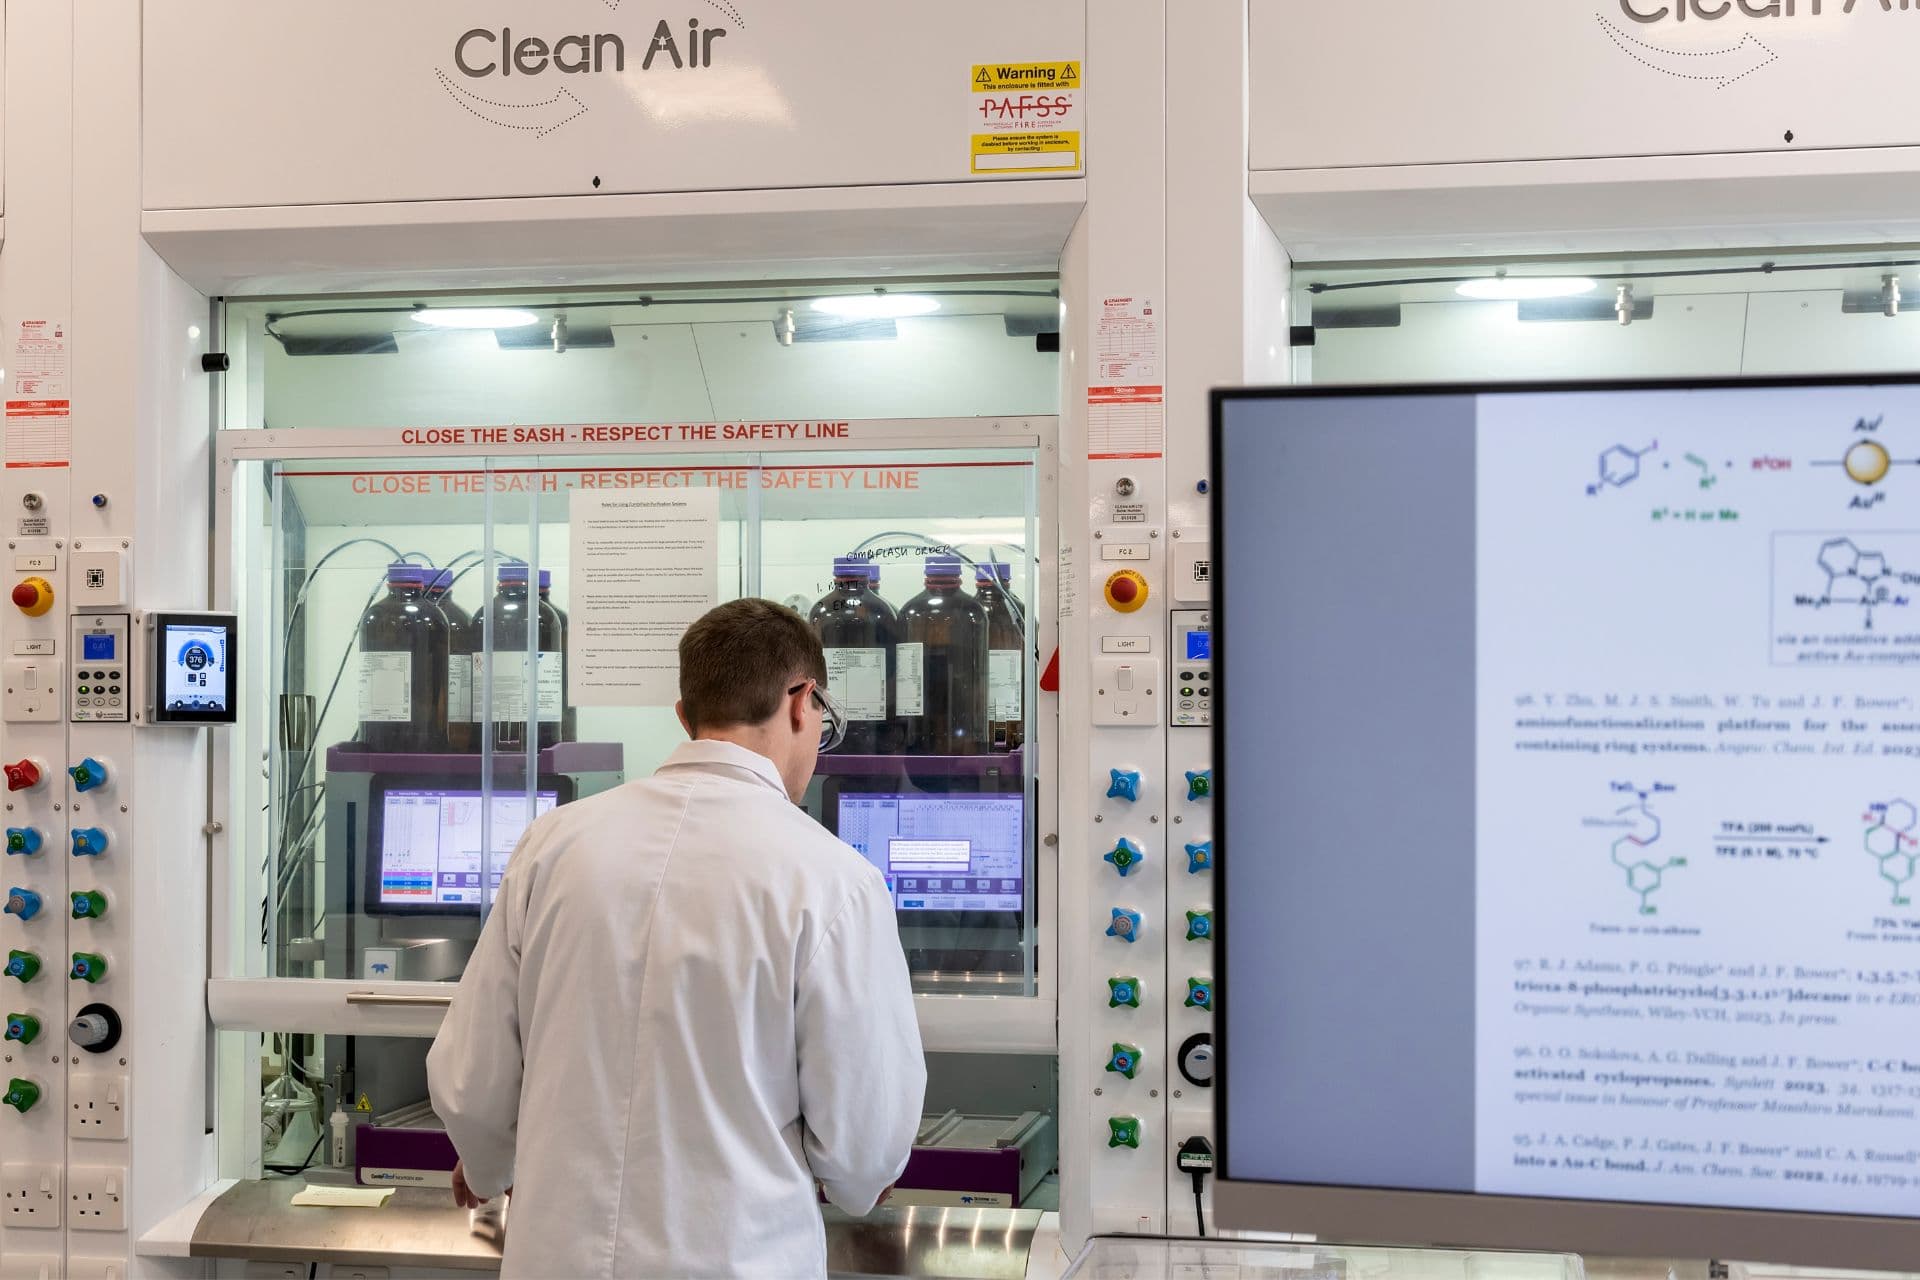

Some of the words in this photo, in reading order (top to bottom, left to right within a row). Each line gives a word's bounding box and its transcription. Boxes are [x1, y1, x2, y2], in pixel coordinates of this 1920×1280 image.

[454, 26, 625, 77] Clean
[642, 18, 727, 71] Air
[996, 66, 1056, 80] Warning
[401, 428, 464, 444] CLOSE
[470, 428, 507, 443] THE
[513, 427, 564, 442] SASH
[582, 426, 672, 442] RESPECT
[678, 425, 716, 440] THE
[722, 424, 798, 440] SAFETY
[804, 423, 849, 438] LINE
[352, 476, 432, 494] CLOSE
[439, 474, 484, 493] THE
[580, 471, 694, 489] RESPECT
[702, 471, 748, 489] THE
[760, 470, 853, 489] SAFETY
[864, 470, 919, 488] LINE
[915, 544, 950, 556] ORDER
[1804, 718, 1828, 732] for
[1842, 719, 1867, 731] the
